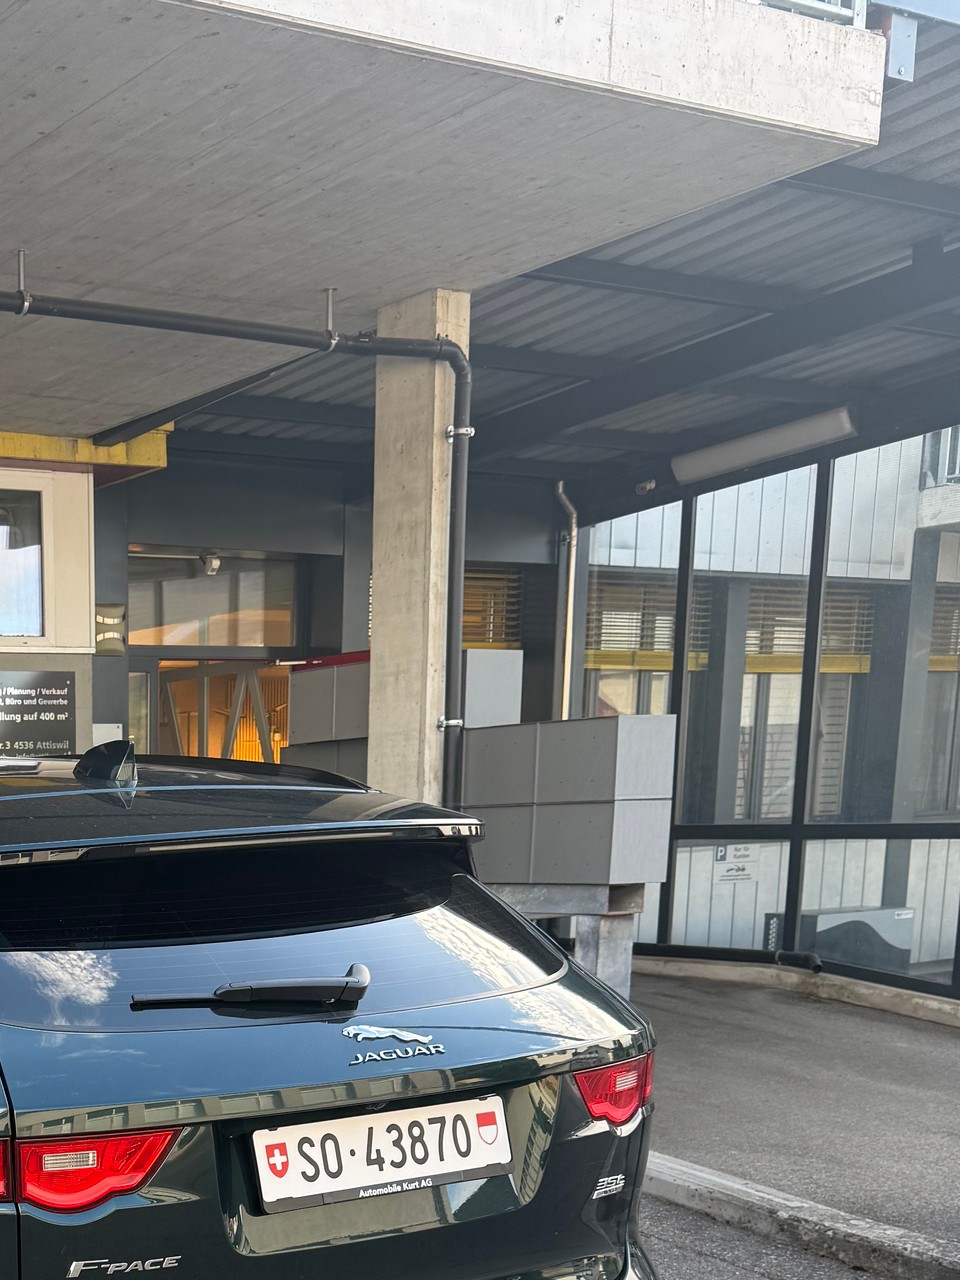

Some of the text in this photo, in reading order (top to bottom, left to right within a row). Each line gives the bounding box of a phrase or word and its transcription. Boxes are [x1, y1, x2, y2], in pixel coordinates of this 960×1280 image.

[6, 687, 36, 696] Planung
[23, 712, 38, 720] auf
[39, 712, 55, 720] 400
[57, 712, 69, 720] m²
[5, 741, 11, 749] 3
[13, 741, 34, 749] 4536
[36, 740, 69, 749] Attiswil
[717, 847, 725, 860] P
[348, 1043, 446, 1066] JAGUAR
[359, 1178, 433, 1198] Automobile Kurt AG
[66, 1255, 182, 1278] F-PACE
